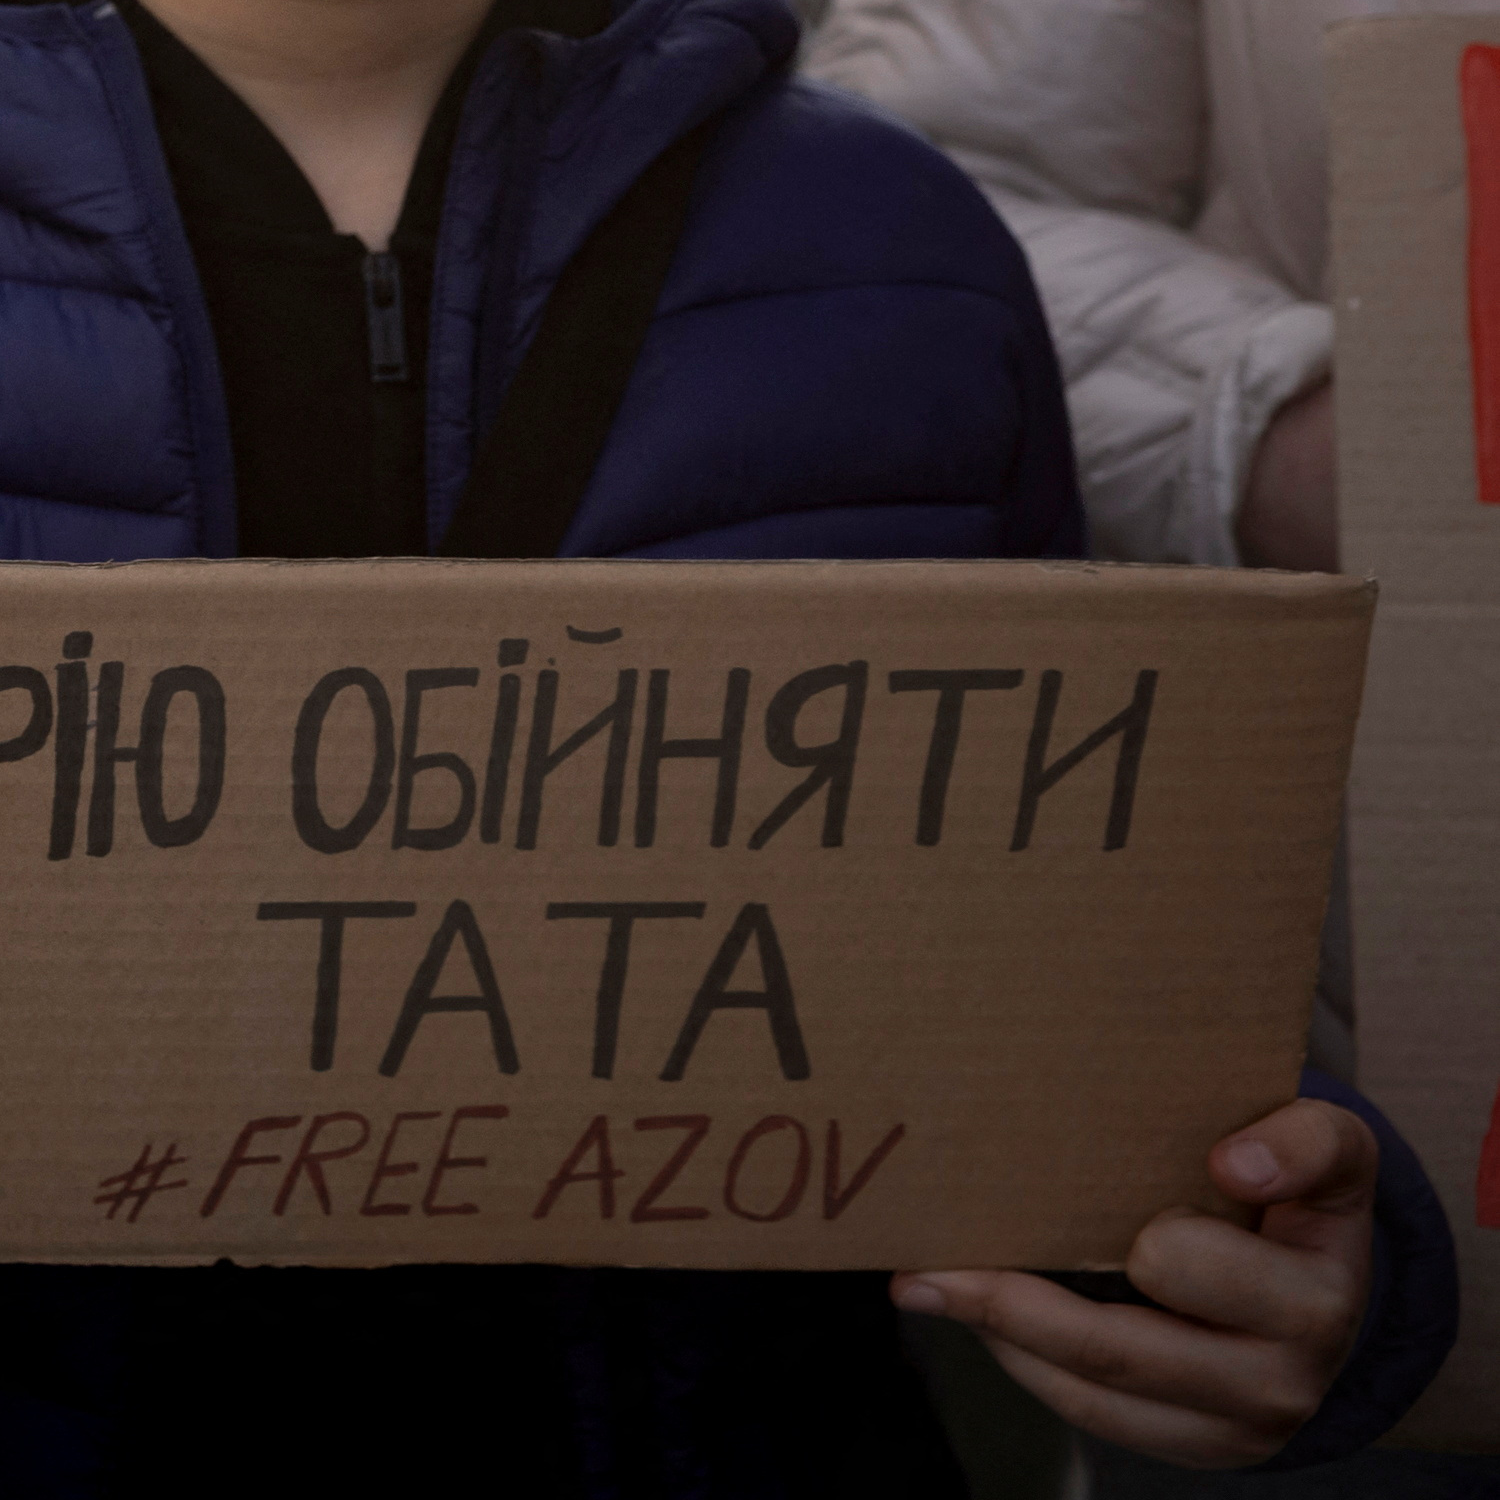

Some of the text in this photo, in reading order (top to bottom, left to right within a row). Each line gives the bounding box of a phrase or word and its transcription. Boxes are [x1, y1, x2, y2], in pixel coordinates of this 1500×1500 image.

[290, 624, 1160, 855] ОБІЙНЯТИ
[255, 899, 811, 1082] ТАТА
[532, 1114, 906, 1223] AZOV
